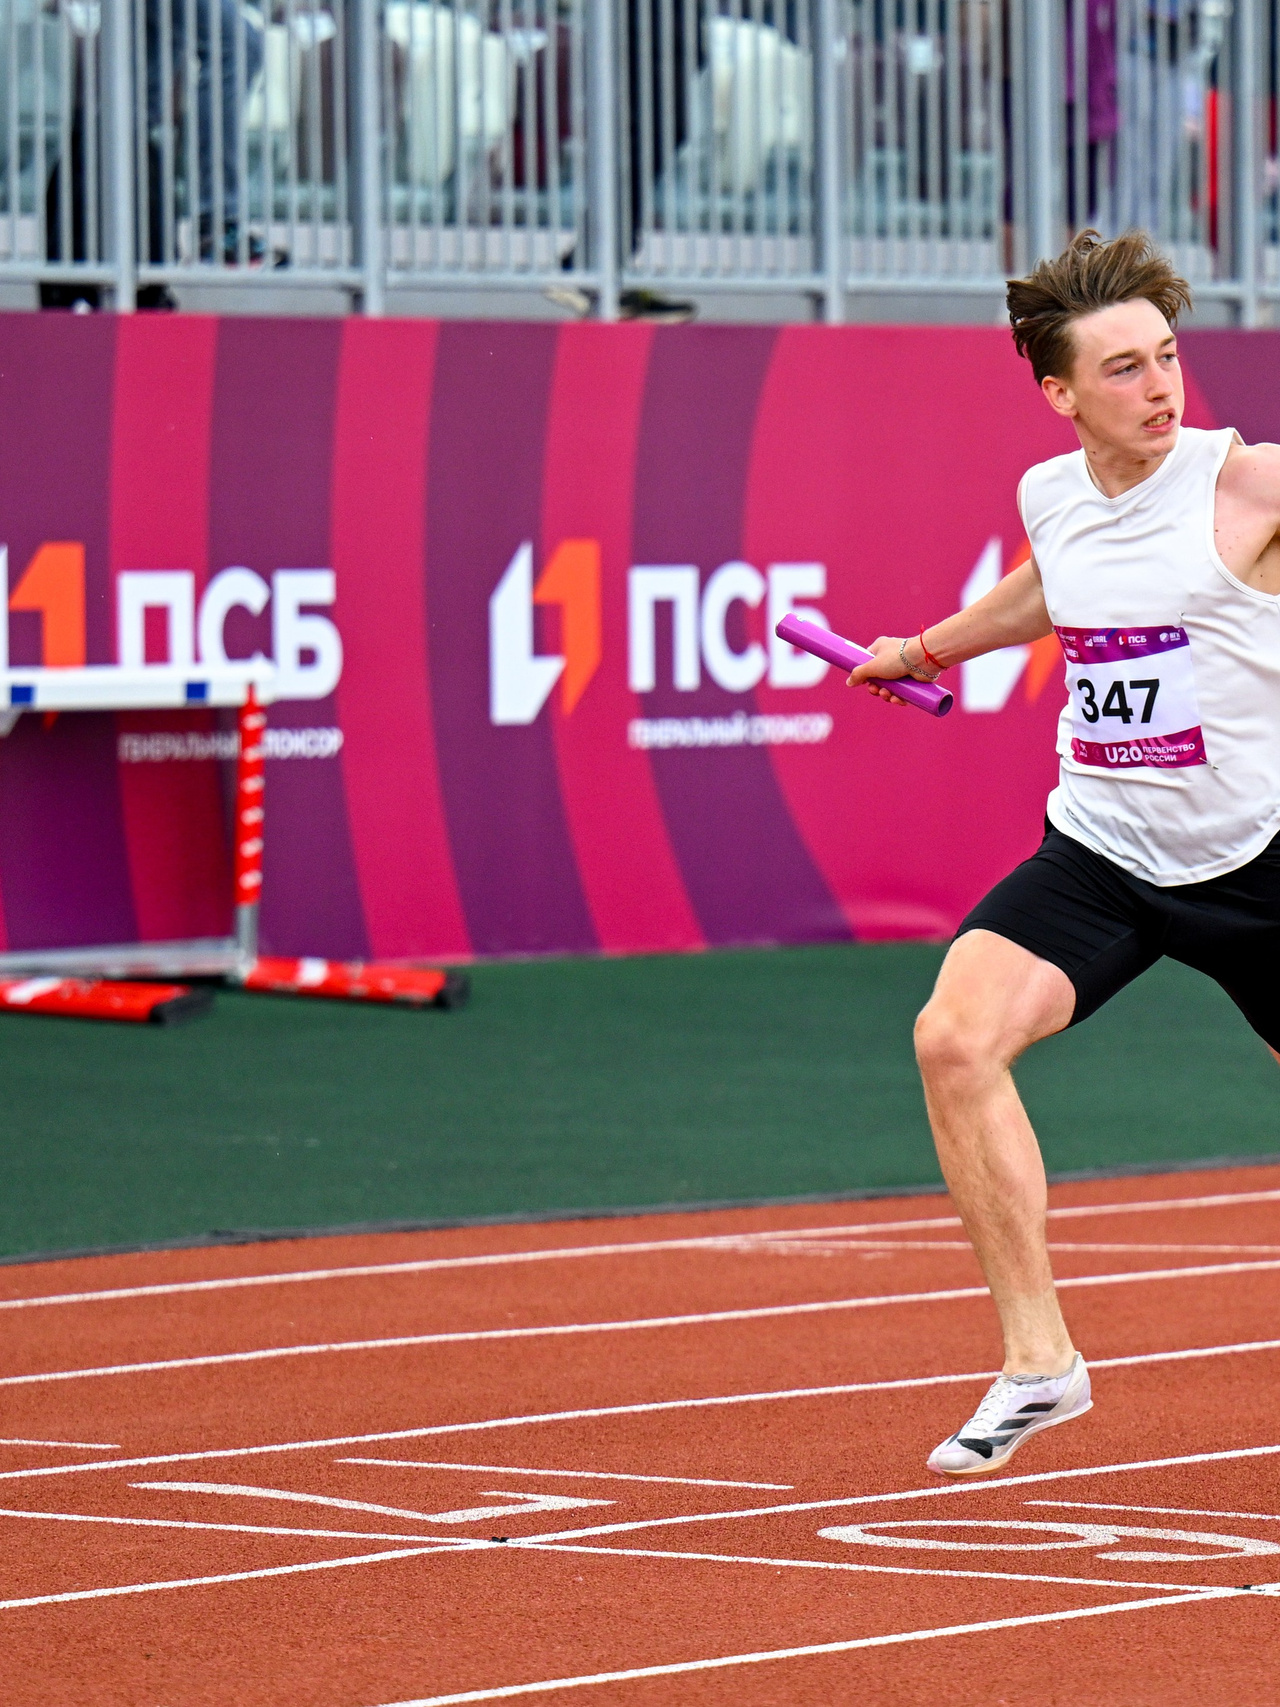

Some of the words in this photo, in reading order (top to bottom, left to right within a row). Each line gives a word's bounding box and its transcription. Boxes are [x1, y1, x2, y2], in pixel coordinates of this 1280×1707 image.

[117, 565, 343, 699] ПСБ
[627, 561, 831, 693] ПСБ
[1128, 635, 1147, 644] ПСБ
[1077, 678, 1160, 725] 347
[748, 712, 833, 746] СПОНСОР
[1105, 746, 1142, 763] U20
[1142, 743, 1196, 755] ПЕРВЕНСТВО
[1145, 753, 1177, 762] РОССИИ
[127, 1481, 618, 1525] 7
